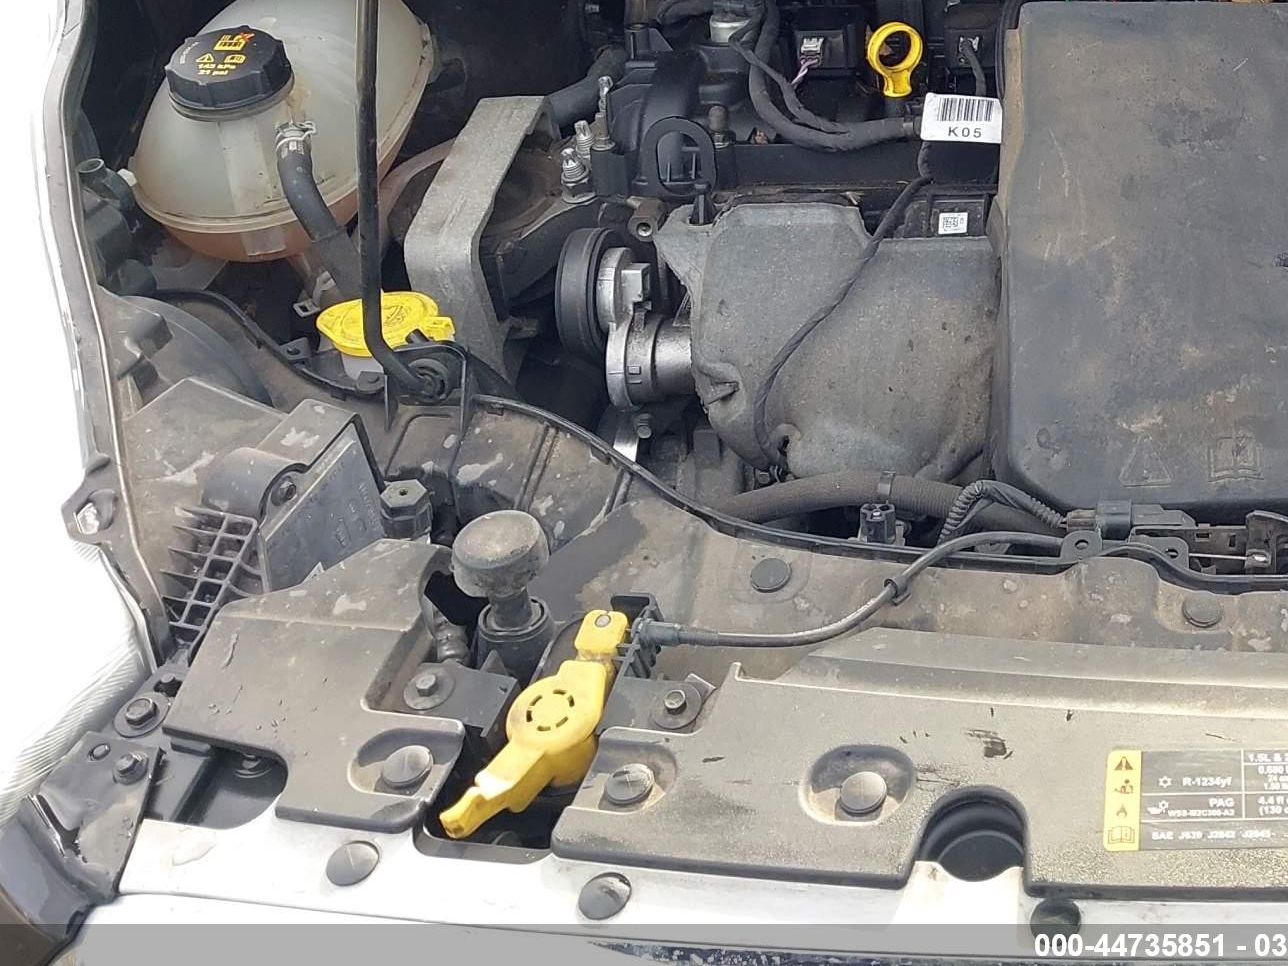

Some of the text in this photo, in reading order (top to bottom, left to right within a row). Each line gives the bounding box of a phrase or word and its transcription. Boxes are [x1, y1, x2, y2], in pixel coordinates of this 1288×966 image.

[948, 126, 982, 138] K05
[1248, 752, 1271, 762] 1.5L
[1182, 776, 1233, 788] R-1234yf
[1208, 797, 1235, 808] PAG
[1257, 796, 1274, 804] 4.4
[1259, 805, 1282, 816] (130
[1151, 831, 1174, 841] SAE
